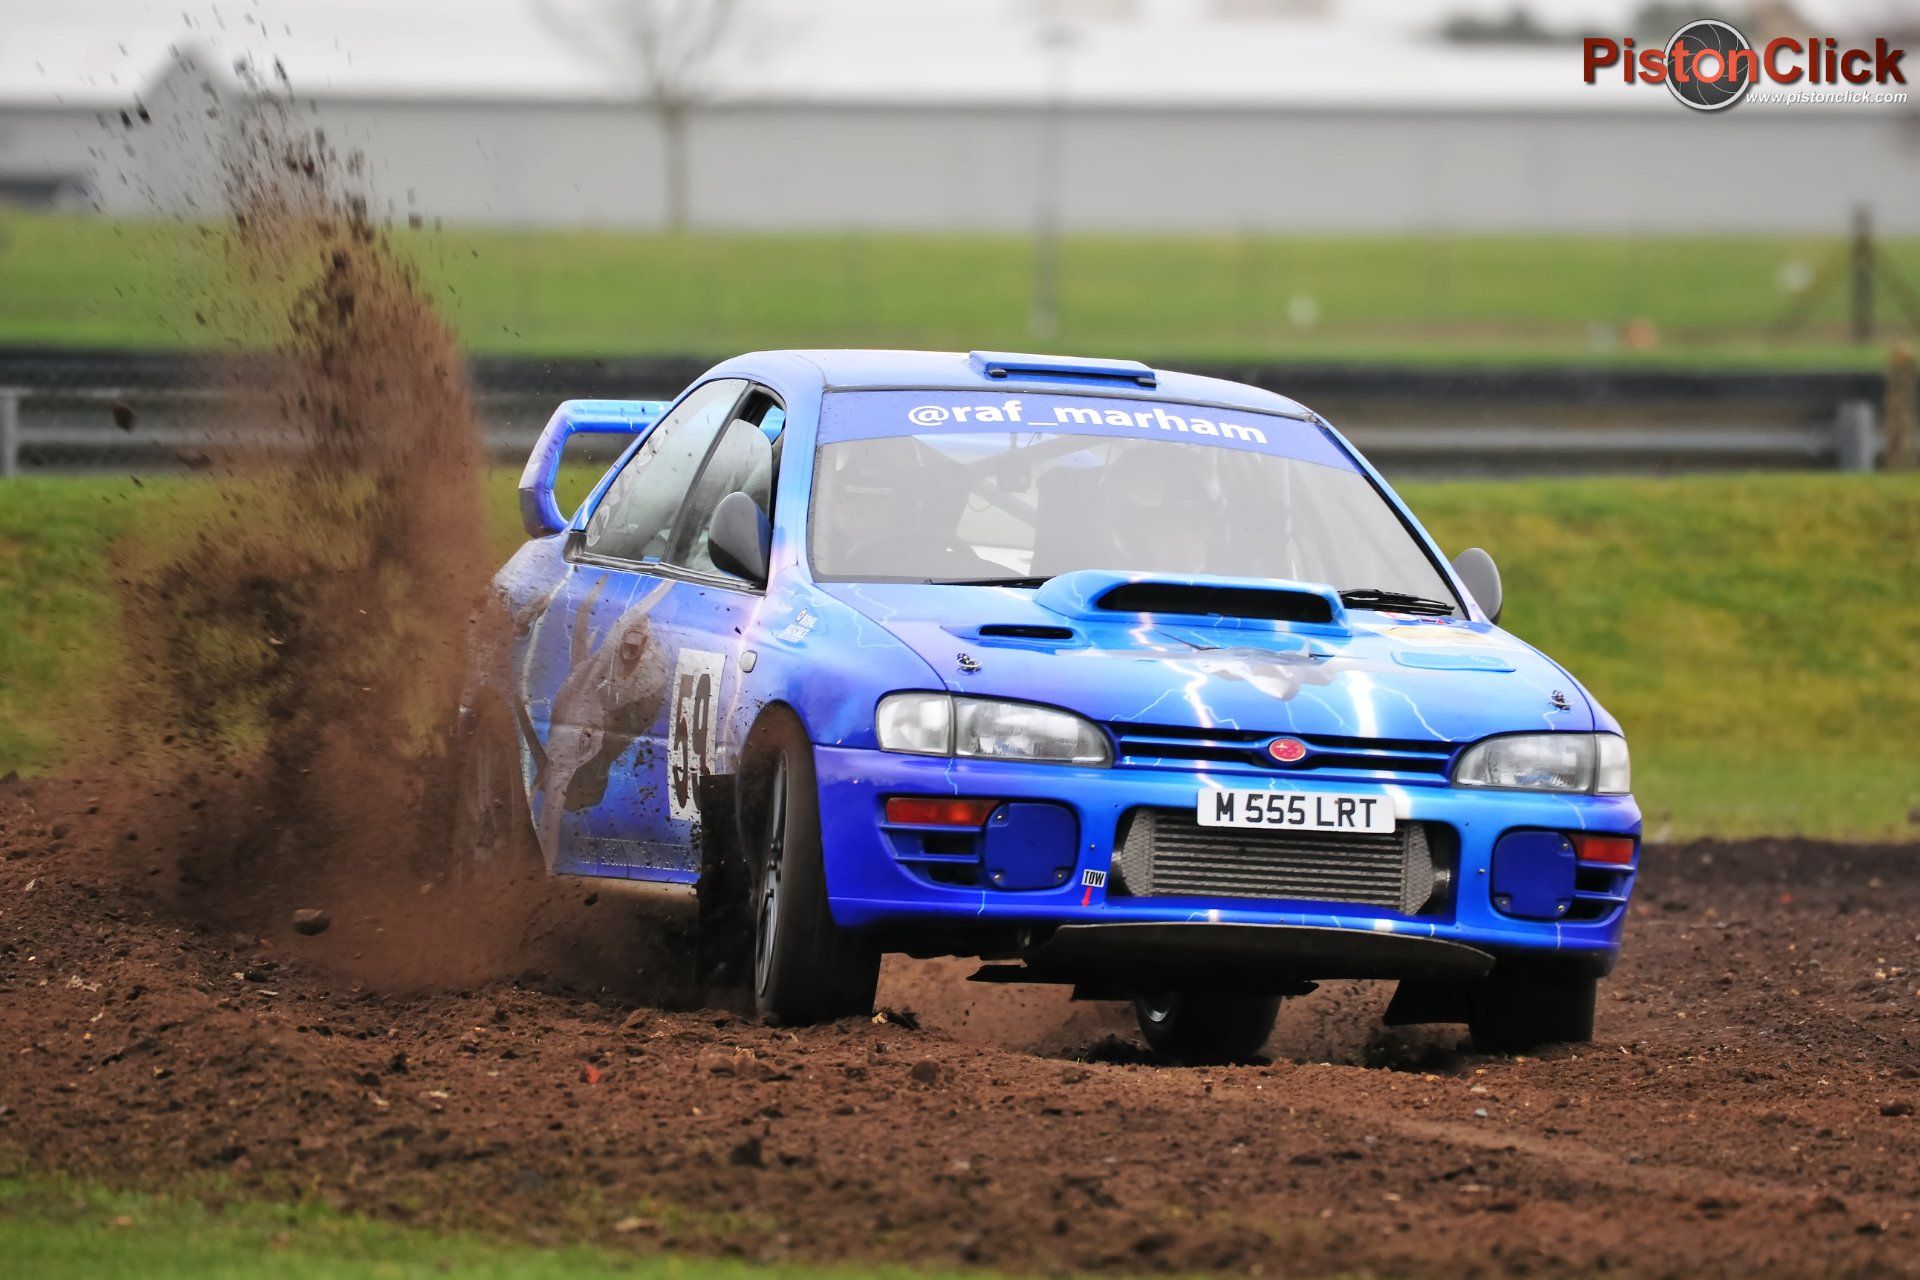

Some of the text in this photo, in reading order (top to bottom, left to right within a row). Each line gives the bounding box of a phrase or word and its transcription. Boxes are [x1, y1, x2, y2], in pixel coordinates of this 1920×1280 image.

[907, 400, 1269, 444] @raf_marham
[672, 673, 712, 810] 59
[1216, 792, 1377, 828] M 555 LRT
[1084, 871, 1105, 886] TOW
